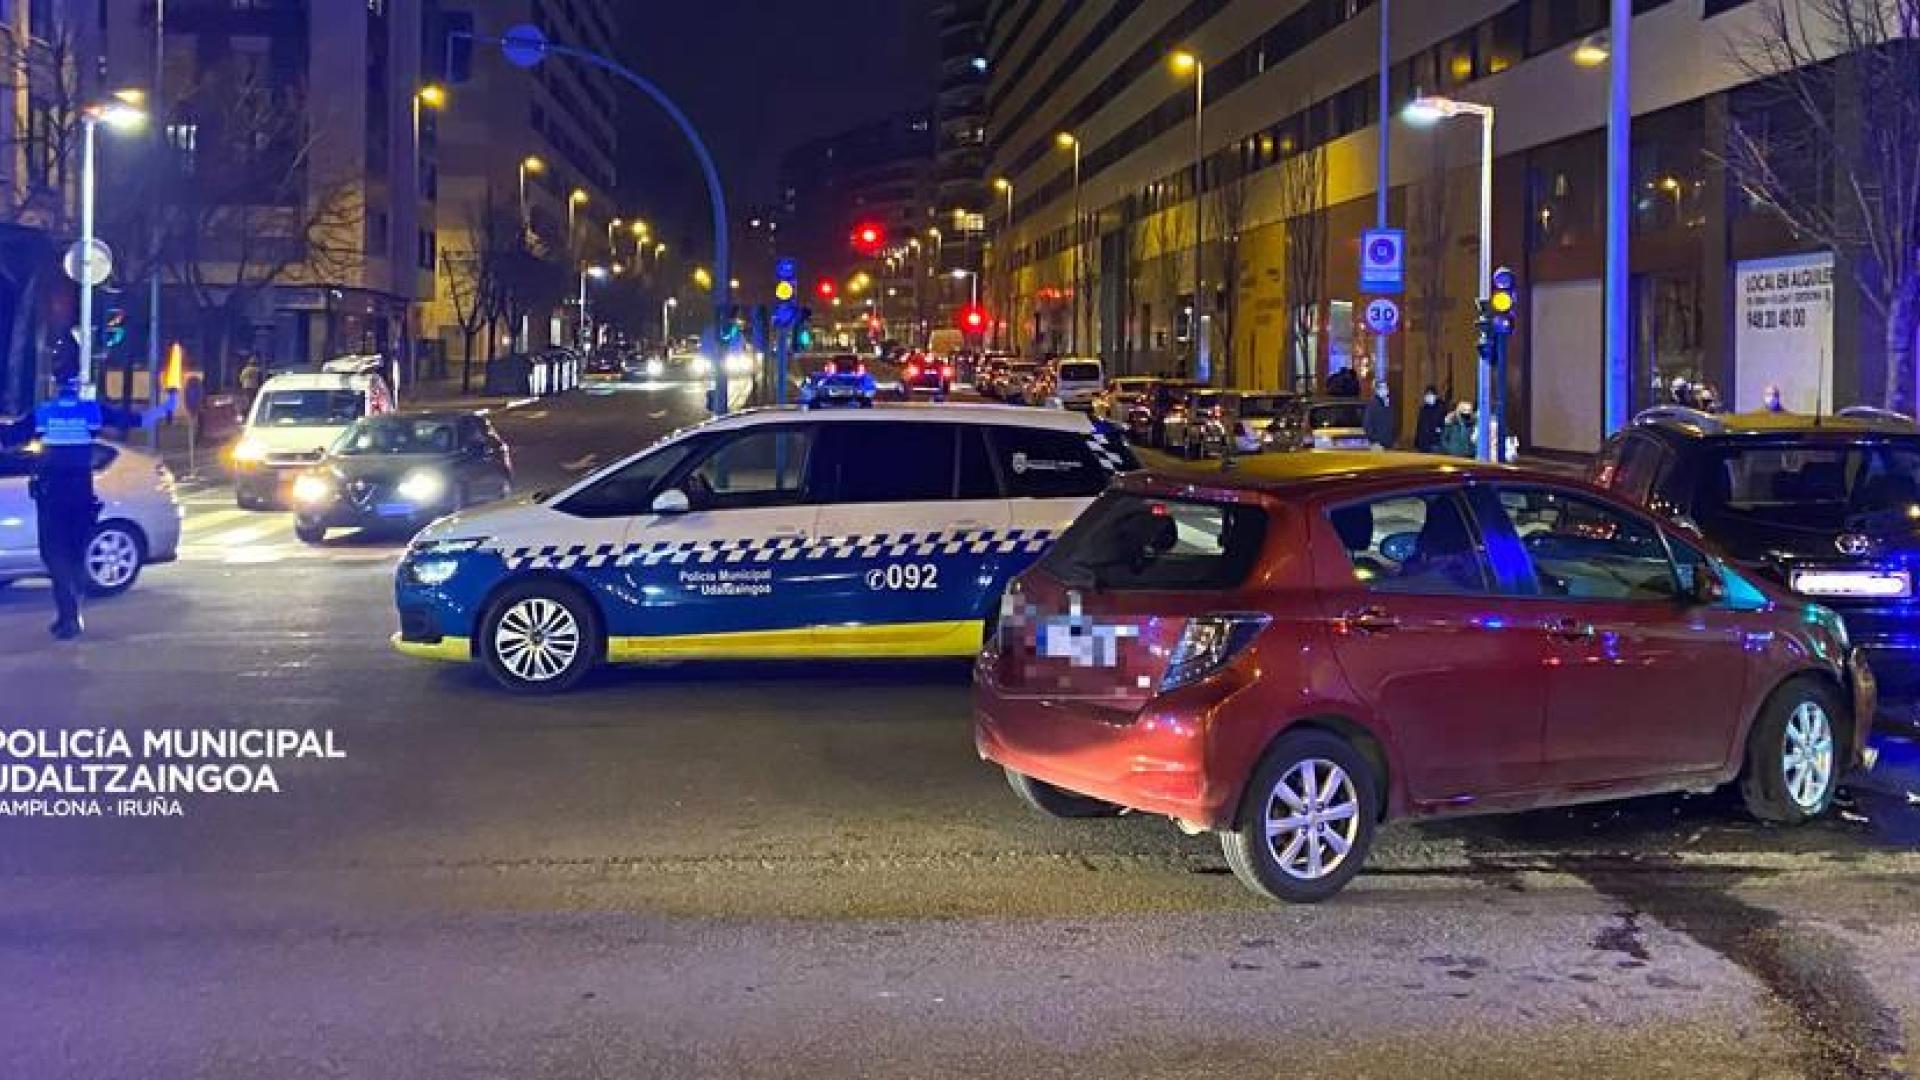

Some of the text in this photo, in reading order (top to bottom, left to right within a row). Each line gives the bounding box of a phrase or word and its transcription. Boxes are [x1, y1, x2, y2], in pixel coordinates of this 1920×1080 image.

[1370, 306, 1394, 321] 30
[718, 568, 772, 582] Municipal
[886, 563, 938, 590] 092
